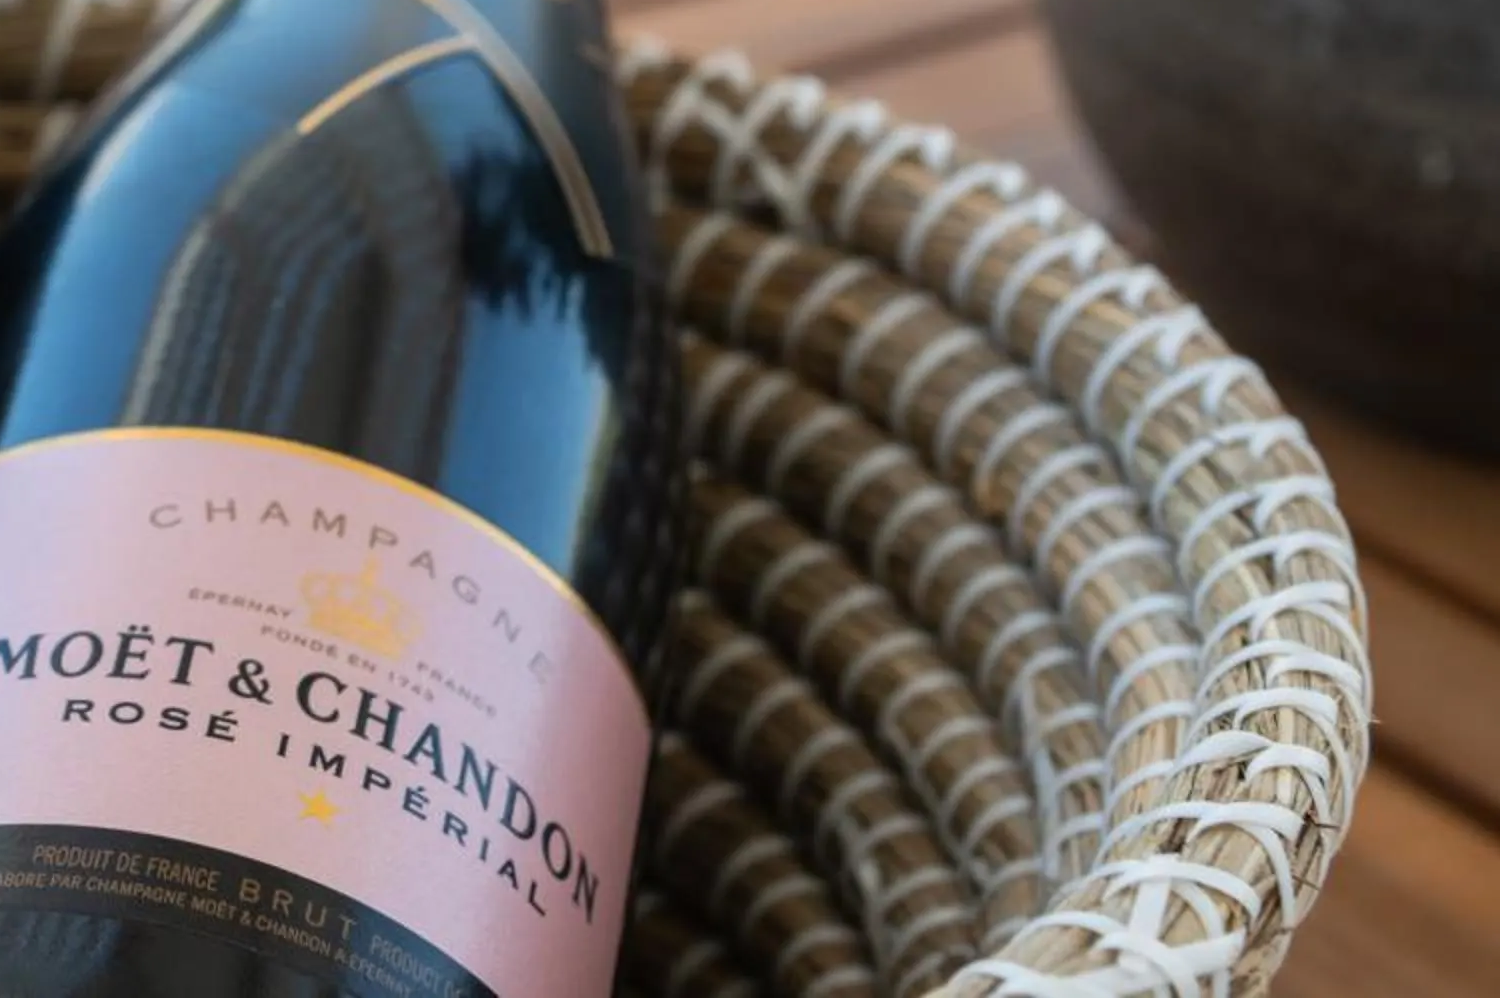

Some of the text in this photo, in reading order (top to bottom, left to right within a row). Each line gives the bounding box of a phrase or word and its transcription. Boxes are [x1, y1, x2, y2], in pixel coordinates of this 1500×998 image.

[149, 499, 555, 686] CHAMPAGNE
[416, 661, 498, 718] FRANCE
[62, 696, 549, 918] ROSÉ IMPÉRIAL
[228, 658, 274, 705] &
[296, 671, 601, 928] CHANDON
[33, 844, 114, 873] PRODUIT
[117, 851, 142, 875] DE
[146, 857, 222, 893] FRANCE
[238, 877, 358, 942] BRUT
[370, 933, 441, 994] PRODUCT
[50, 872, 84, 890] PAR
[86, 875, 187, 907] CHAMPAGNE
[239, 910, 251, 927] &
[254, 913, 332, 957] CHANDON
